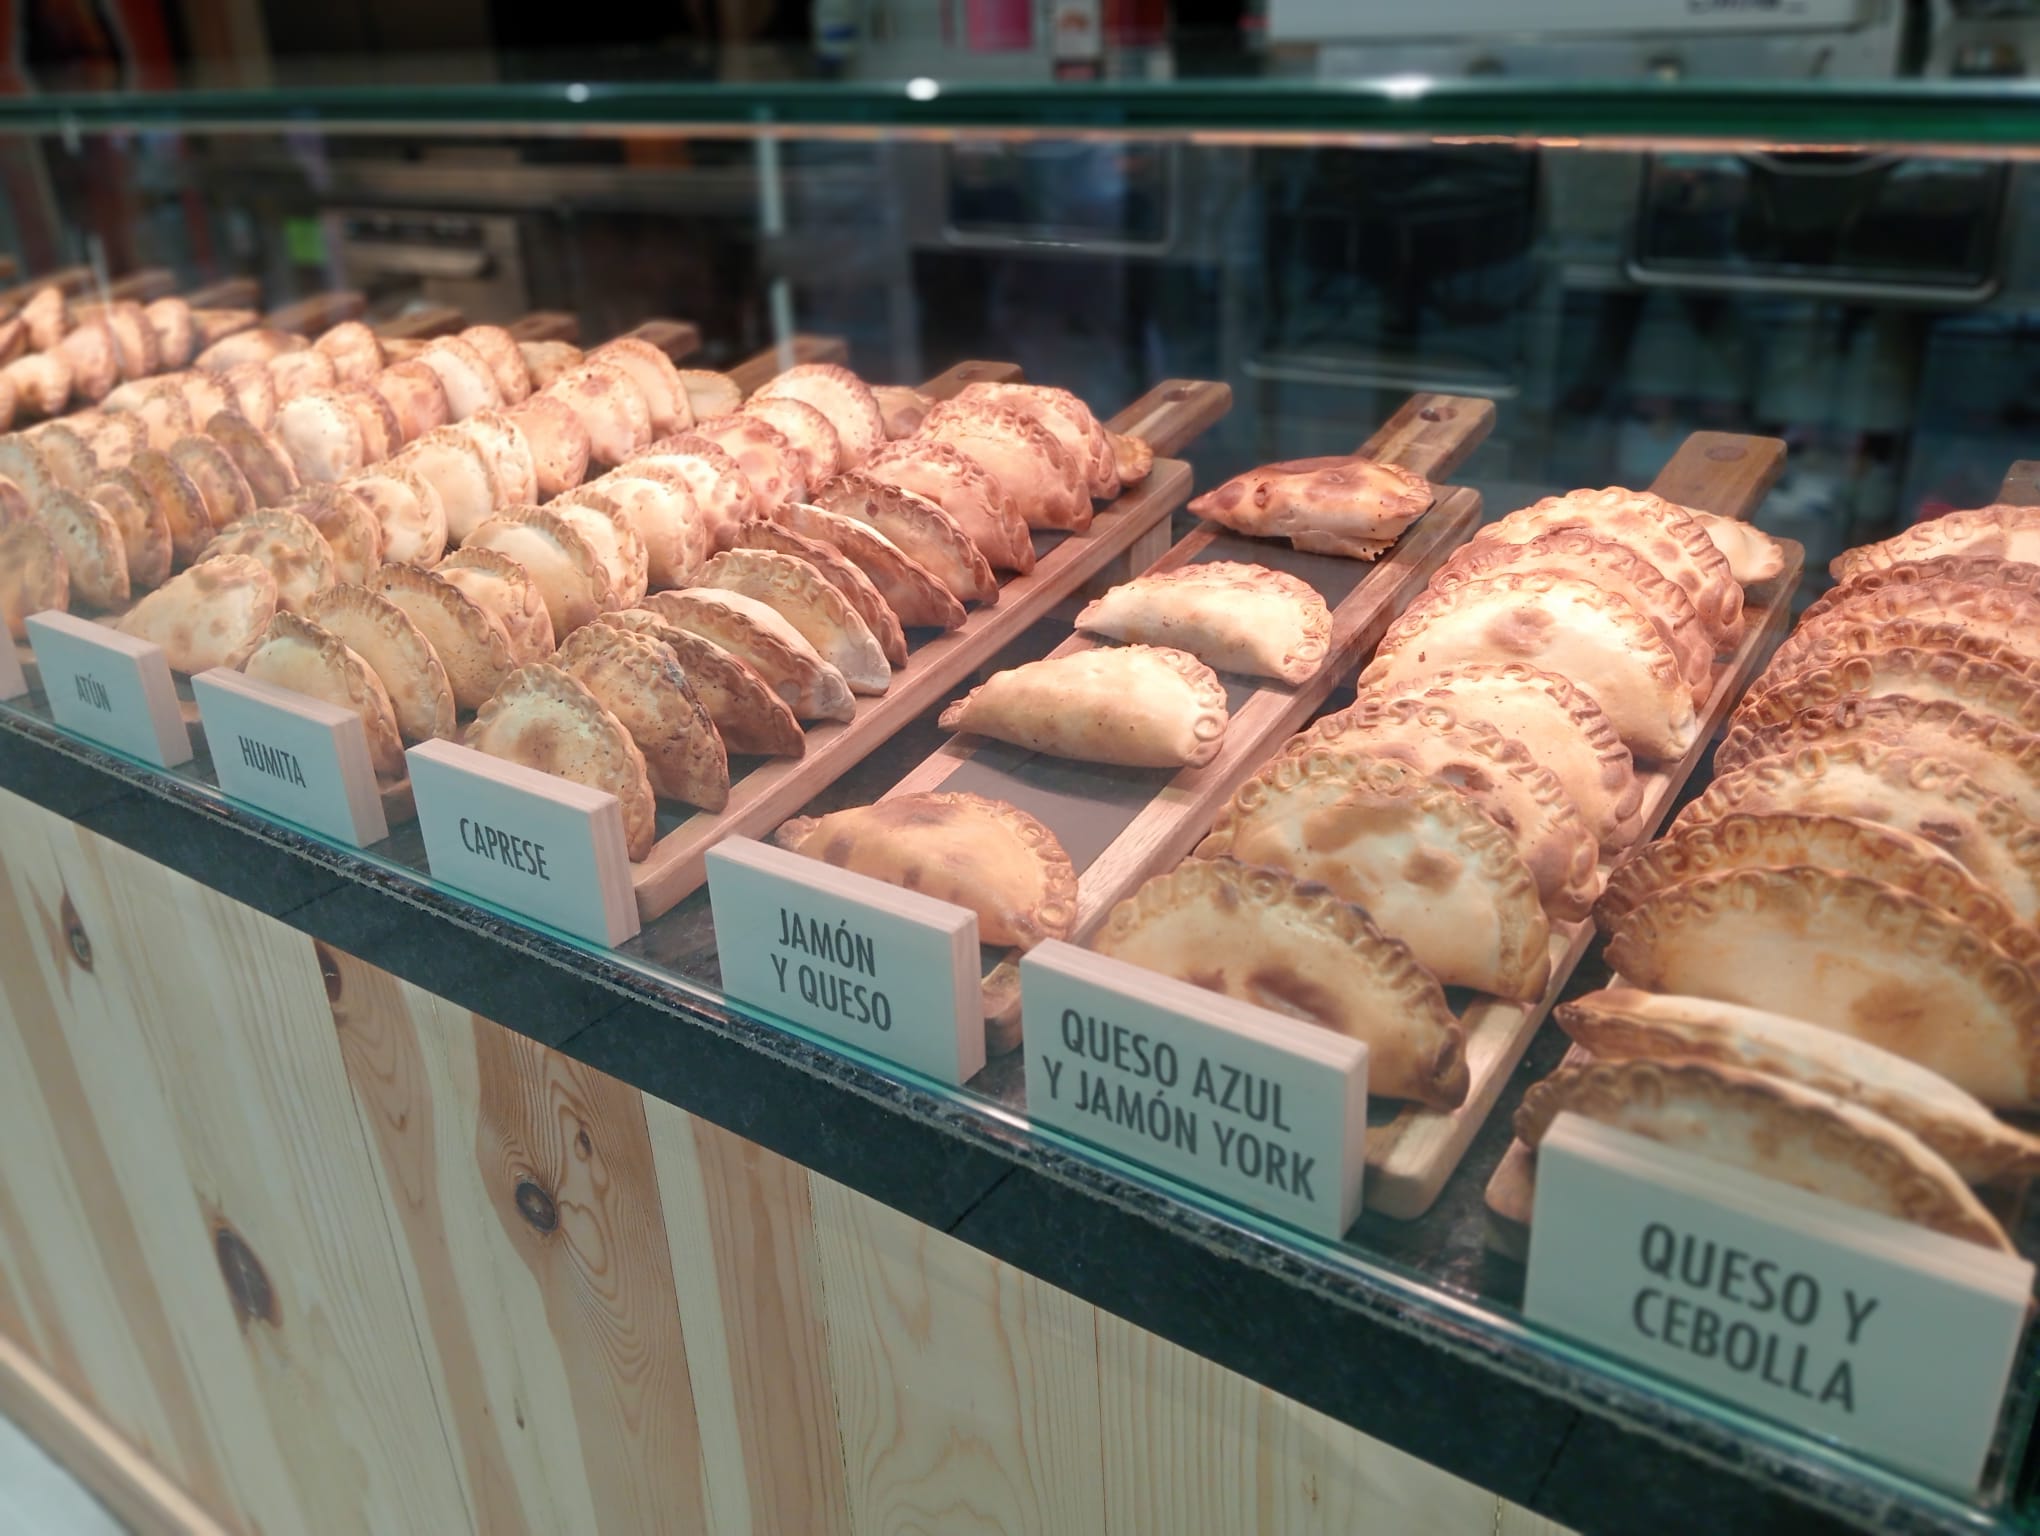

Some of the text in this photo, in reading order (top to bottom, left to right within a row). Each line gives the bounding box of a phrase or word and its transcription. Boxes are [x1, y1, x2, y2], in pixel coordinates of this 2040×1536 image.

[74, 673, 113, 713] ATÚN
[238, 735, 306, 788] HUMITA
[459, 818, 550, 881] CAPRESE
[778, 907, 876, 977] JAMÓN
[770, 952, 892, 1032] Y QUESO
[1061, 1008, 1291, 1133] QUESO AZUL
[1042, 1055, 1315, 1202] Y JAMÓN YORK
[1639, 1222, 1880, 1345] QUESO Y
[1632, 1287, 1855, 1414] CEBOLLA
